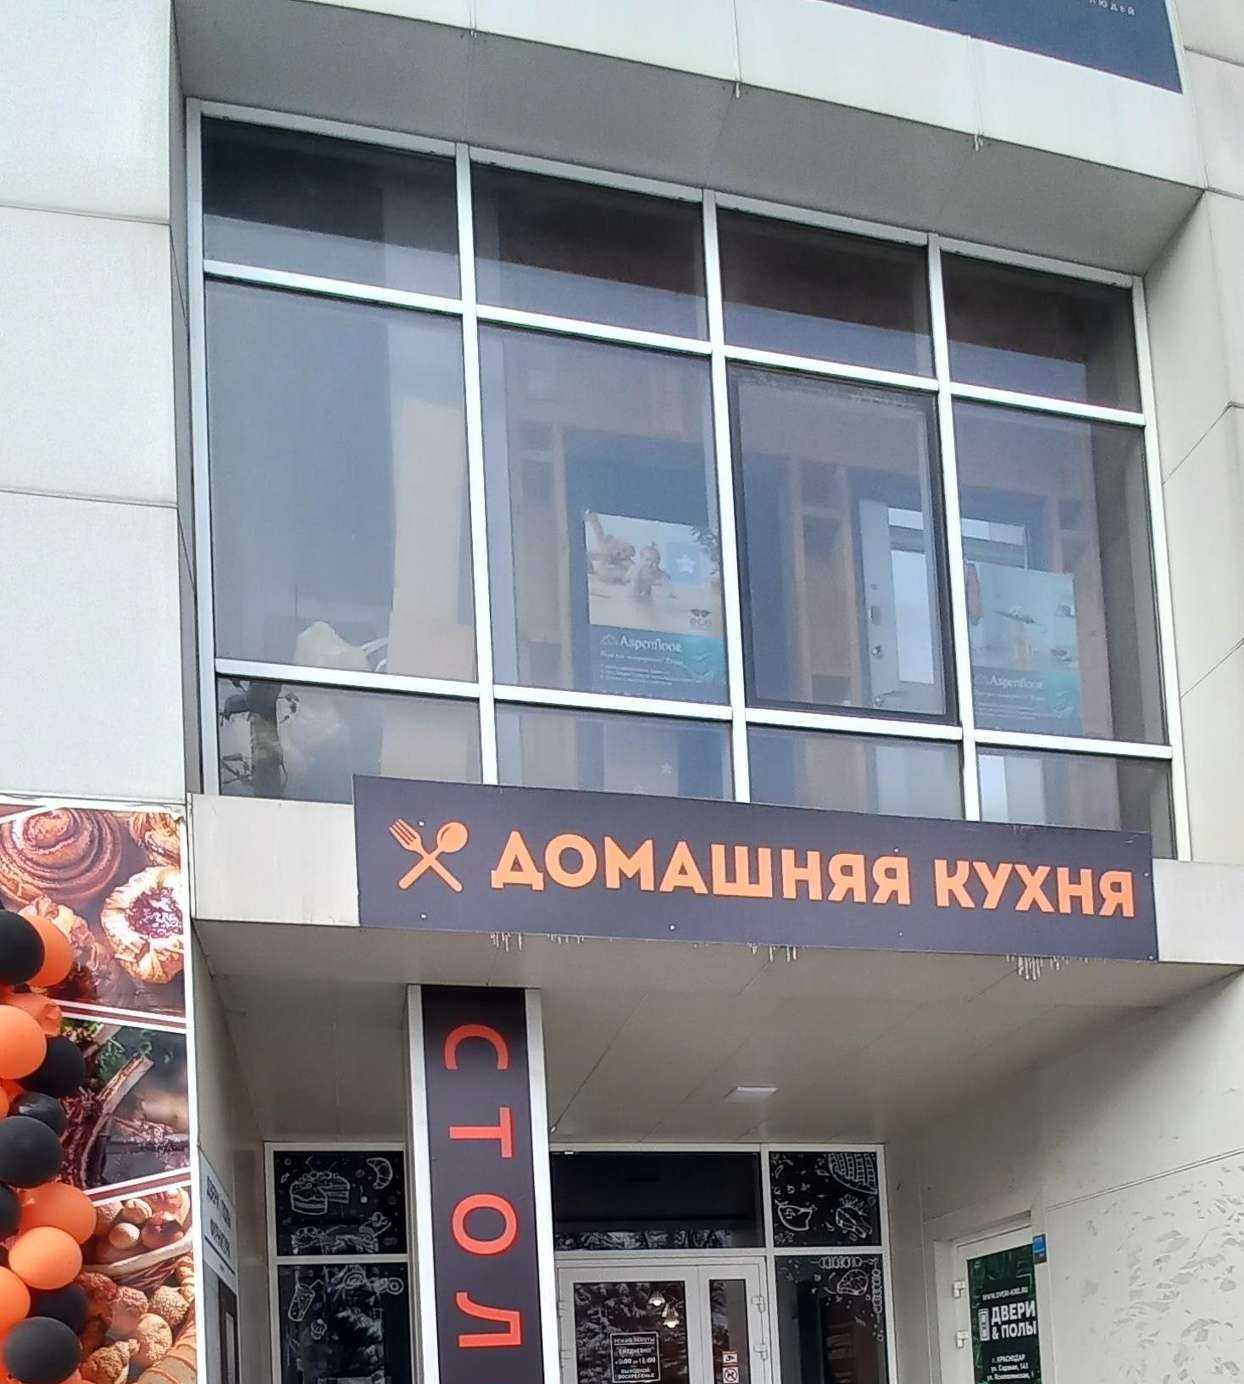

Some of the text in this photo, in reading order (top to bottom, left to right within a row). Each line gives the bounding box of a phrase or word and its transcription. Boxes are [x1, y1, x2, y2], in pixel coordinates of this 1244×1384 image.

[490, 829, 1135, 918] ДОМАШНЯЯ КУХНЯ
[991, 1300, 1036, 1326] ДВЕРИ
[992, 1326, 1000, 1340] &
[1001, 1321, 1037, 1338] ПОЛЫ
